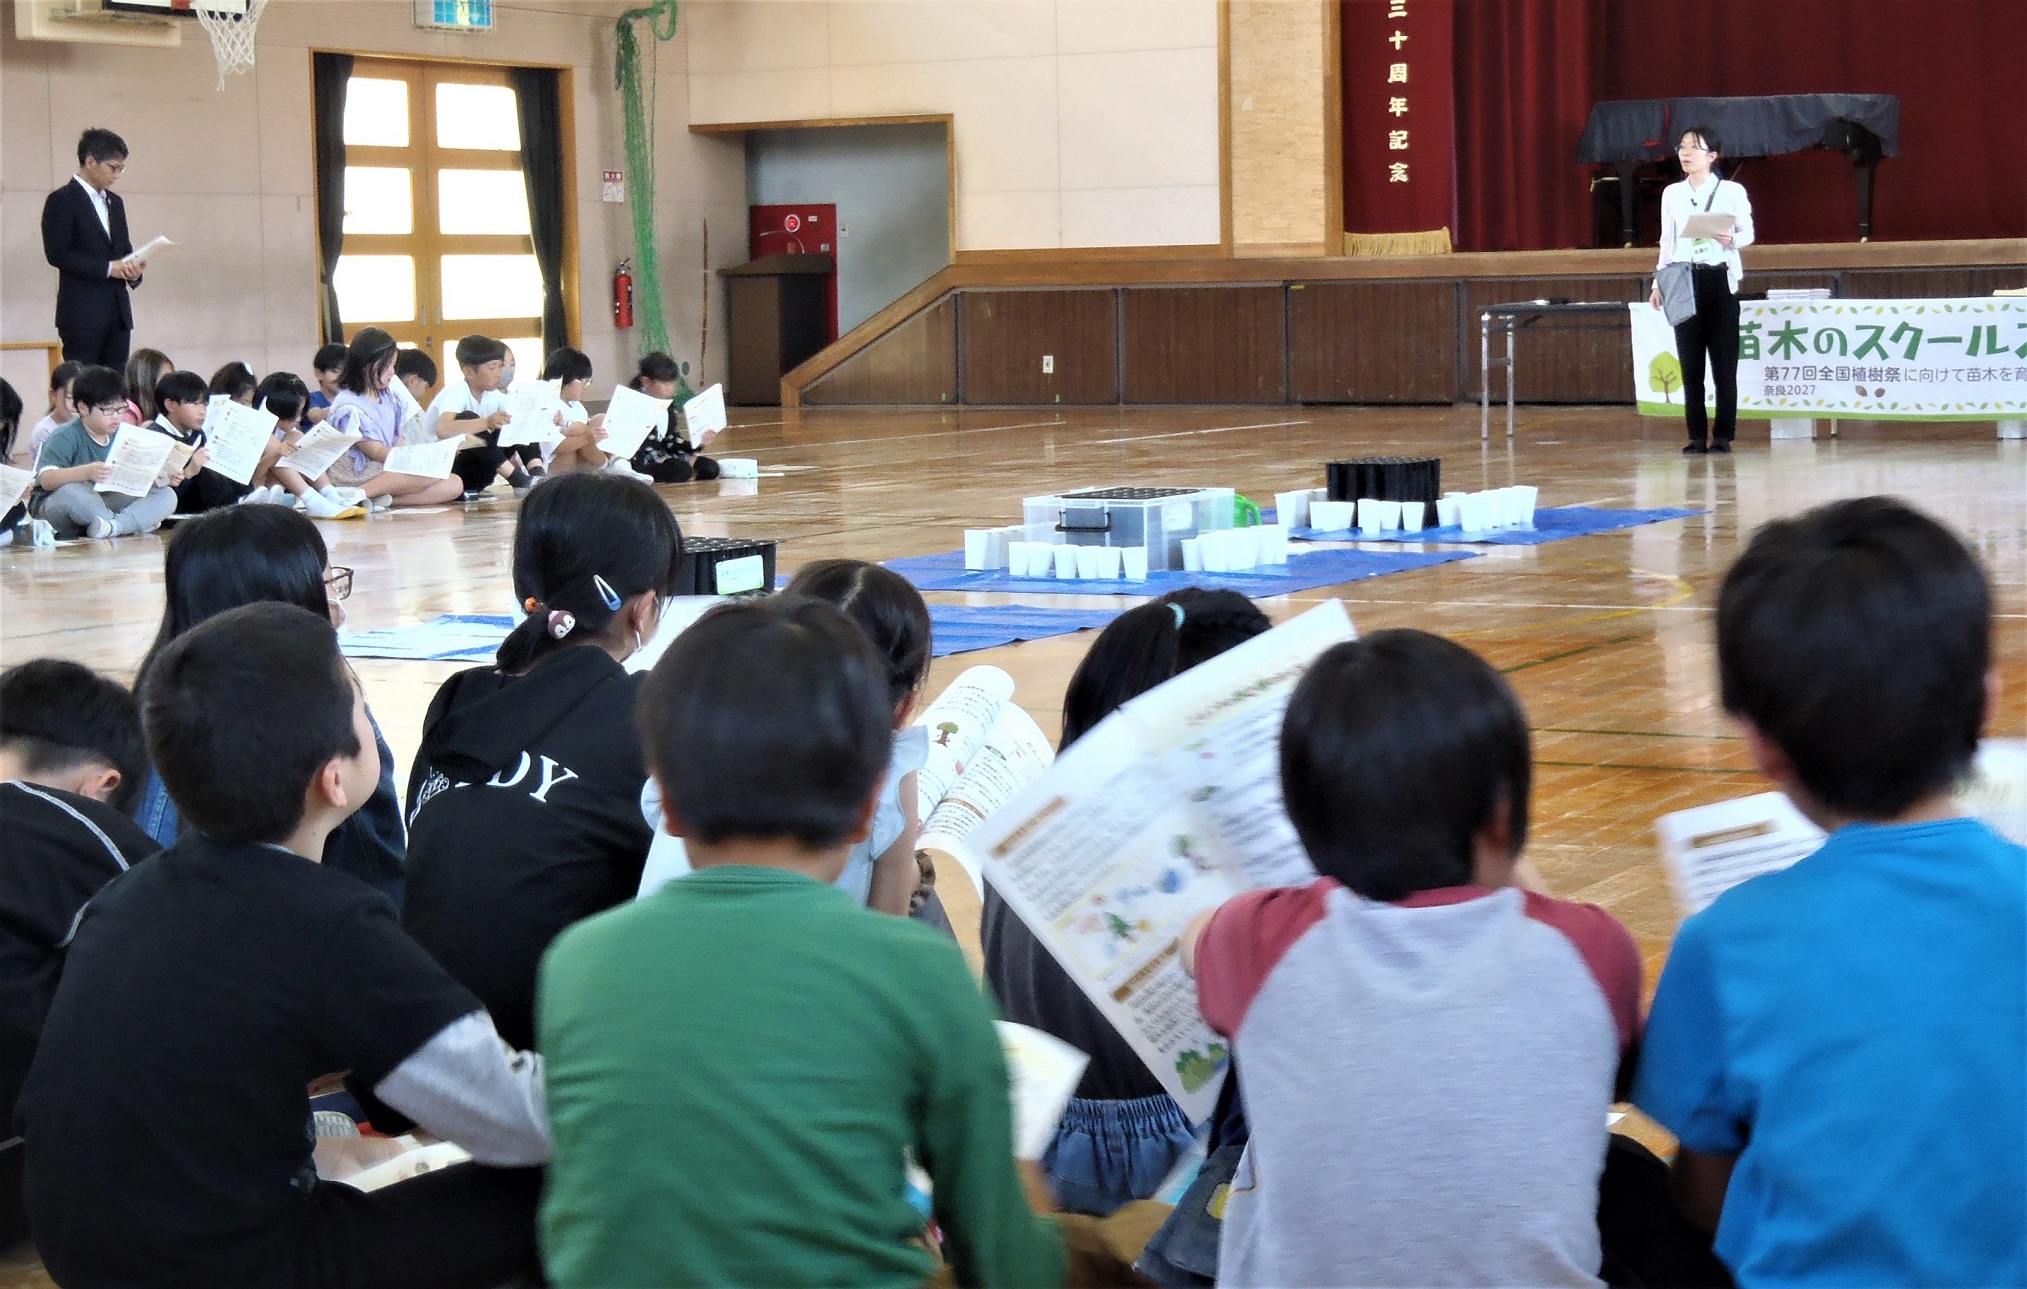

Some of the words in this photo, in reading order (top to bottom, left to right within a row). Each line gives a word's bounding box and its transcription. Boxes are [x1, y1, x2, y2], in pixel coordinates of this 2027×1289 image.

[1387, 0, 1409, 183] 三十周年記念
[1738, 320, 2027, 361] 苗木のスクール
[1763, 384, 1817, 396] 奈良2027
